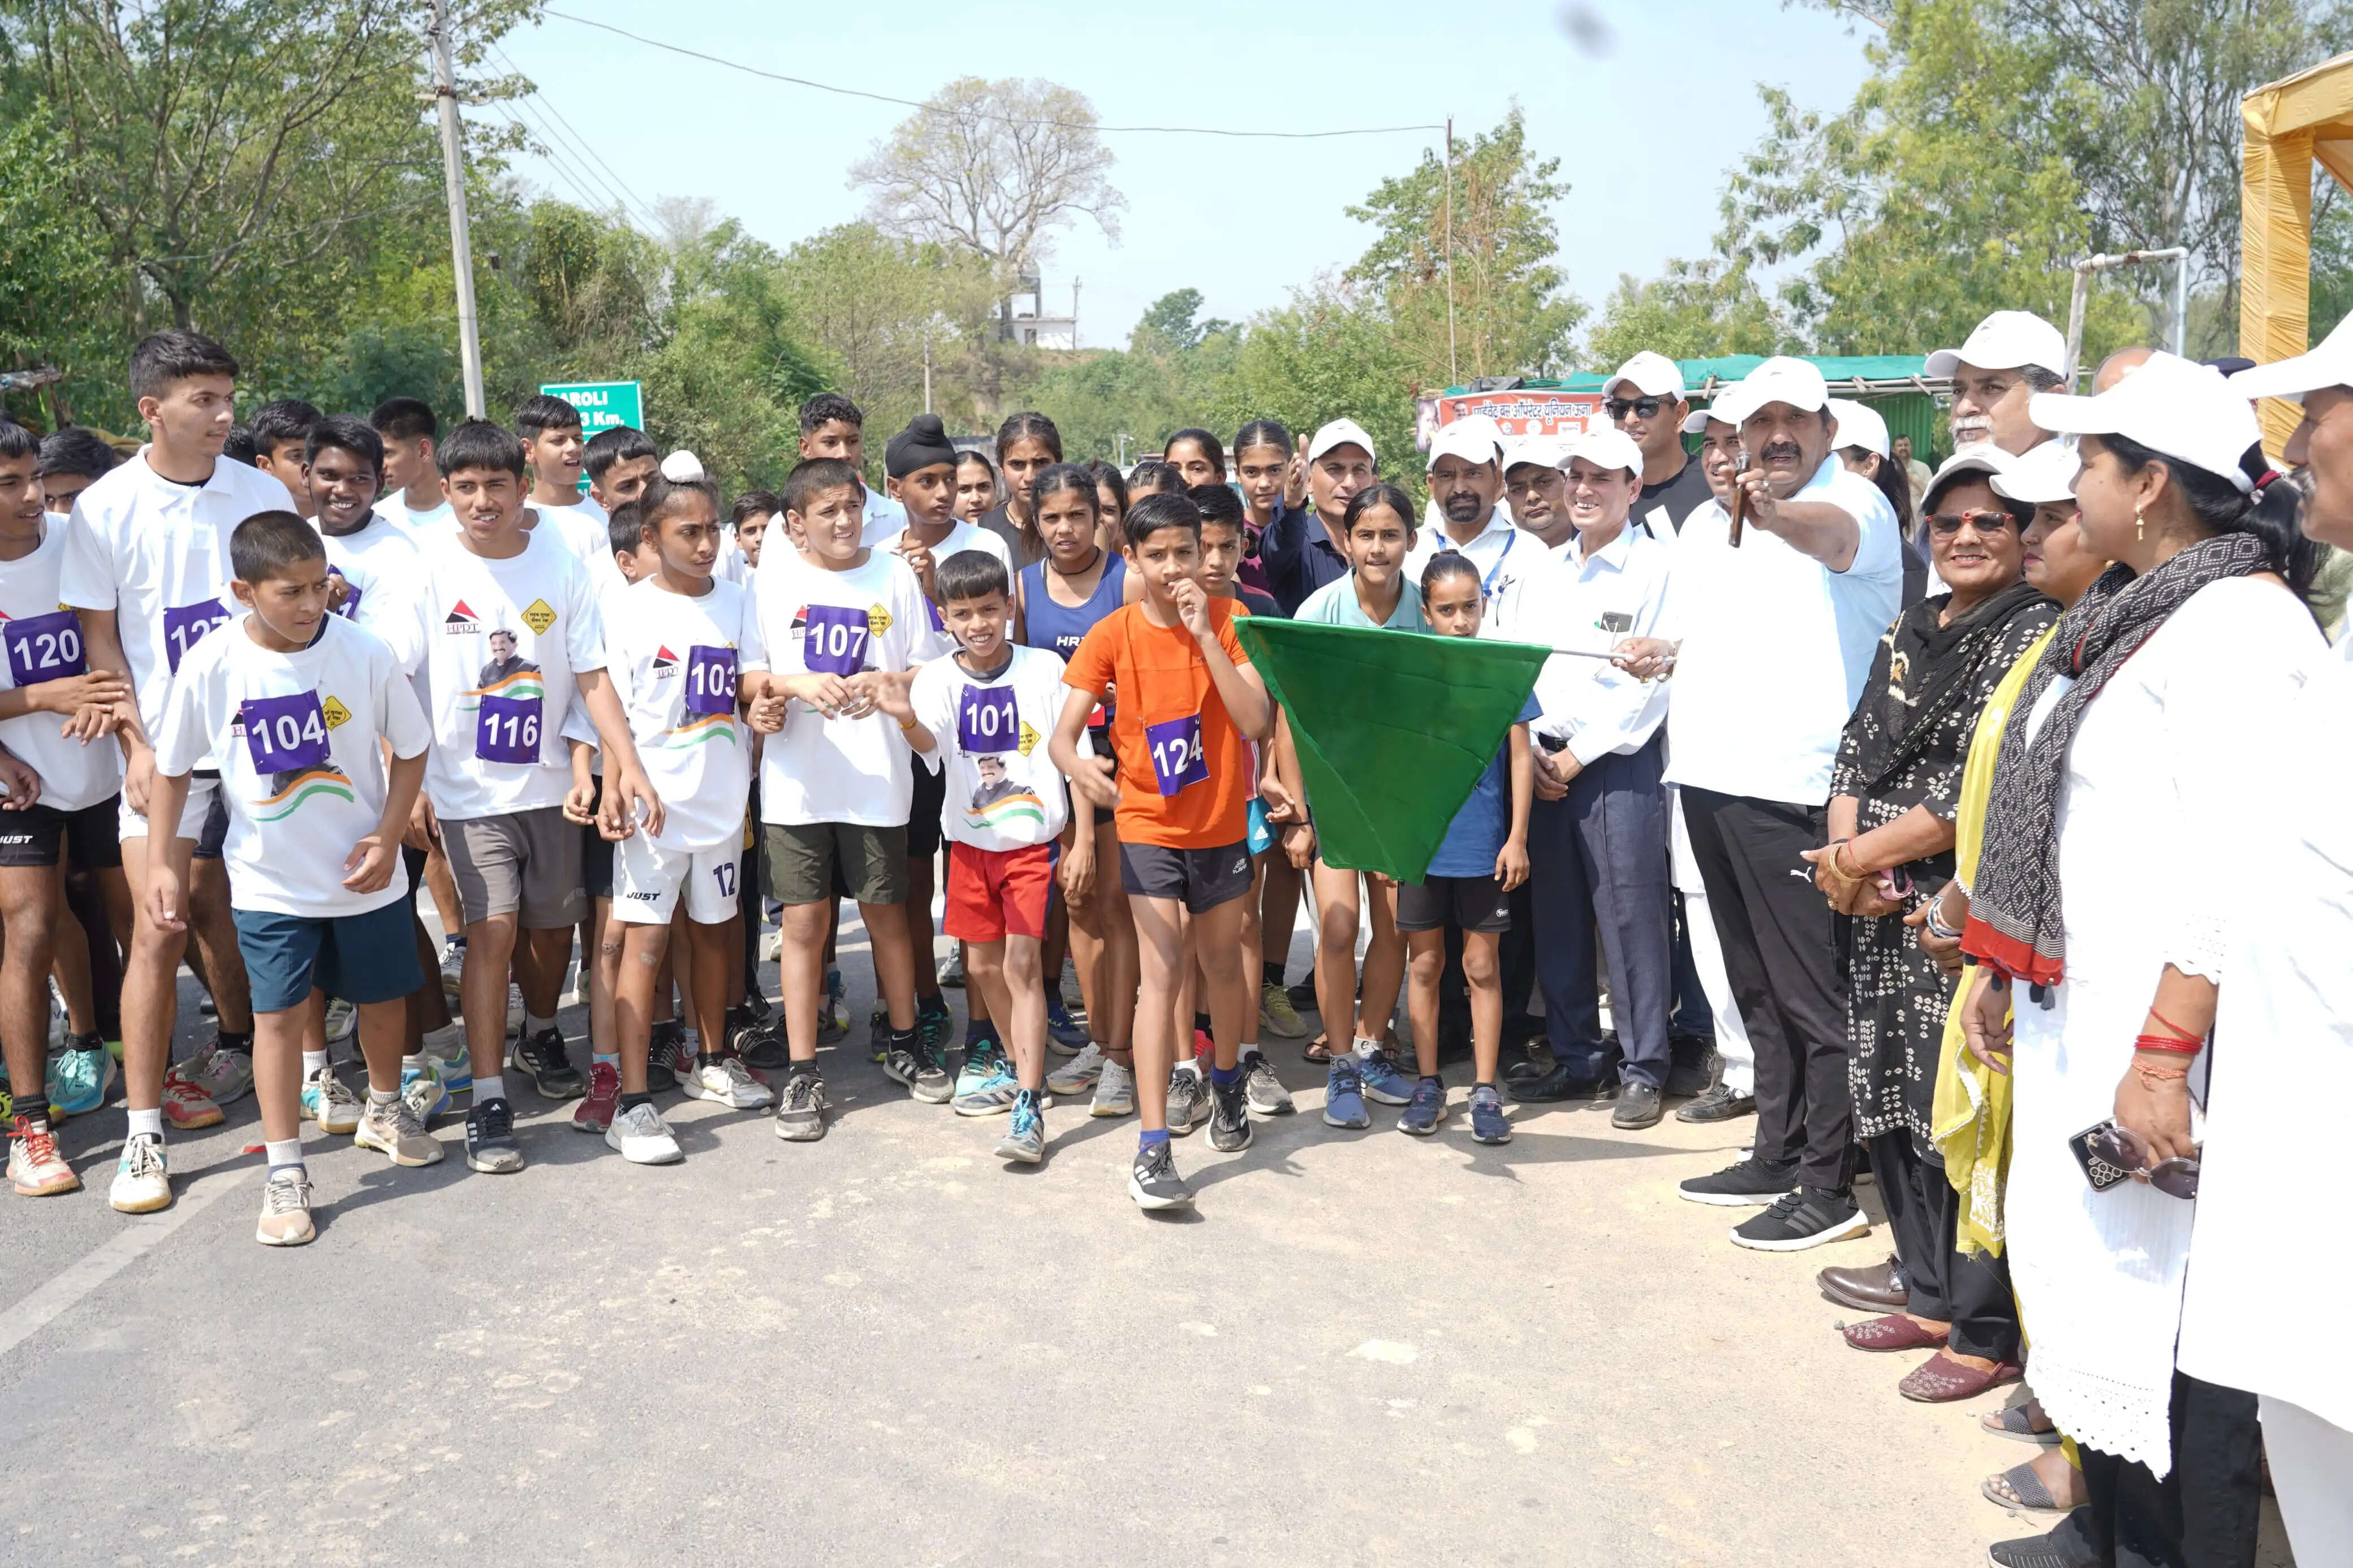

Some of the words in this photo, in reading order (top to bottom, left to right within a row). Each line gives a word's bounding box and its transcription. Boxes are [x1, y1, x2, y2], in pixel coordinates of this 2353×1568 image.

[593, 411, 625, 426] Km.
[447, 623, 480, 632] HPDT
[811, 622, 868, 658] 107
[14, 629, 80, 671] 120
[691, 662, 736, 697] 103
[252, 709, 325, 754] 104
[485, 712, 538, 748] 116
[966, 702, 1015, 737] 101
[1153, 728, 1203, 777] 124
[626, 892, 661, 901] JUST
[713, 862, 736, 898] 12
